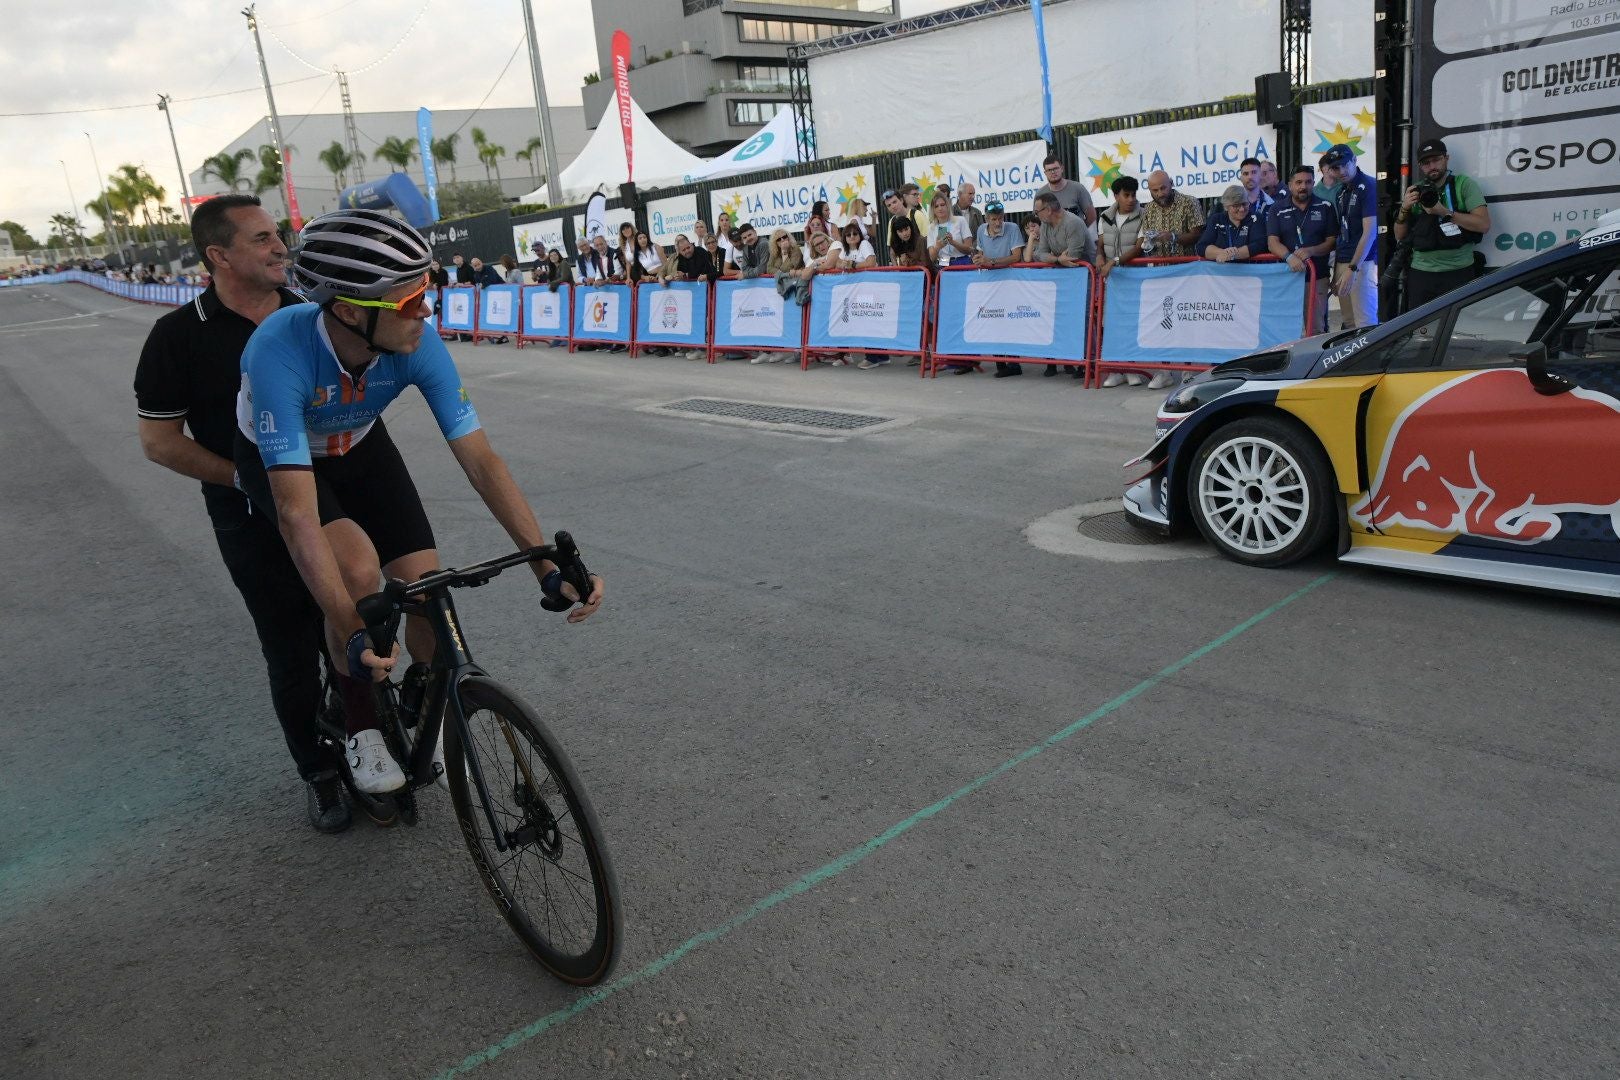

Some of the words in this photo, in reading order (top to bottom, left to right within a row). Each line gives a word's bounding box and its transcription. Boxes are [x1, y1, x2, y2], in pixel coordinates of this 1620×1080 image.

[1550, 2, 1584, 16] Radio
[1570, 15, 1600, 29] 103.8
[617, 55, 631, 127] CRITERIUM
[1544, 87, 1560, 98] BE
[1138, 150, 1165, 173] LA
[1505, 138, 1620, 173] GSPO
[949, 173, 965, 191] LA
[1187, 173, 1209, 186] DEL
[1212, 167, 1242, 184] DEPO
[1002, 187, 1039, 202] DEPORT
[746, 194, 764, 214] LA
[749, 216, 776, 229] CIUDAD
[778, 214, 793, 226] DEL
[794, 211, 813, 224] DEPO
[1176, 302, 1236, 313] GENERALITAT
[1176, 312, 1235, 322] VALENCIANA
[1322, 337, 1369, 369] PULSAR
